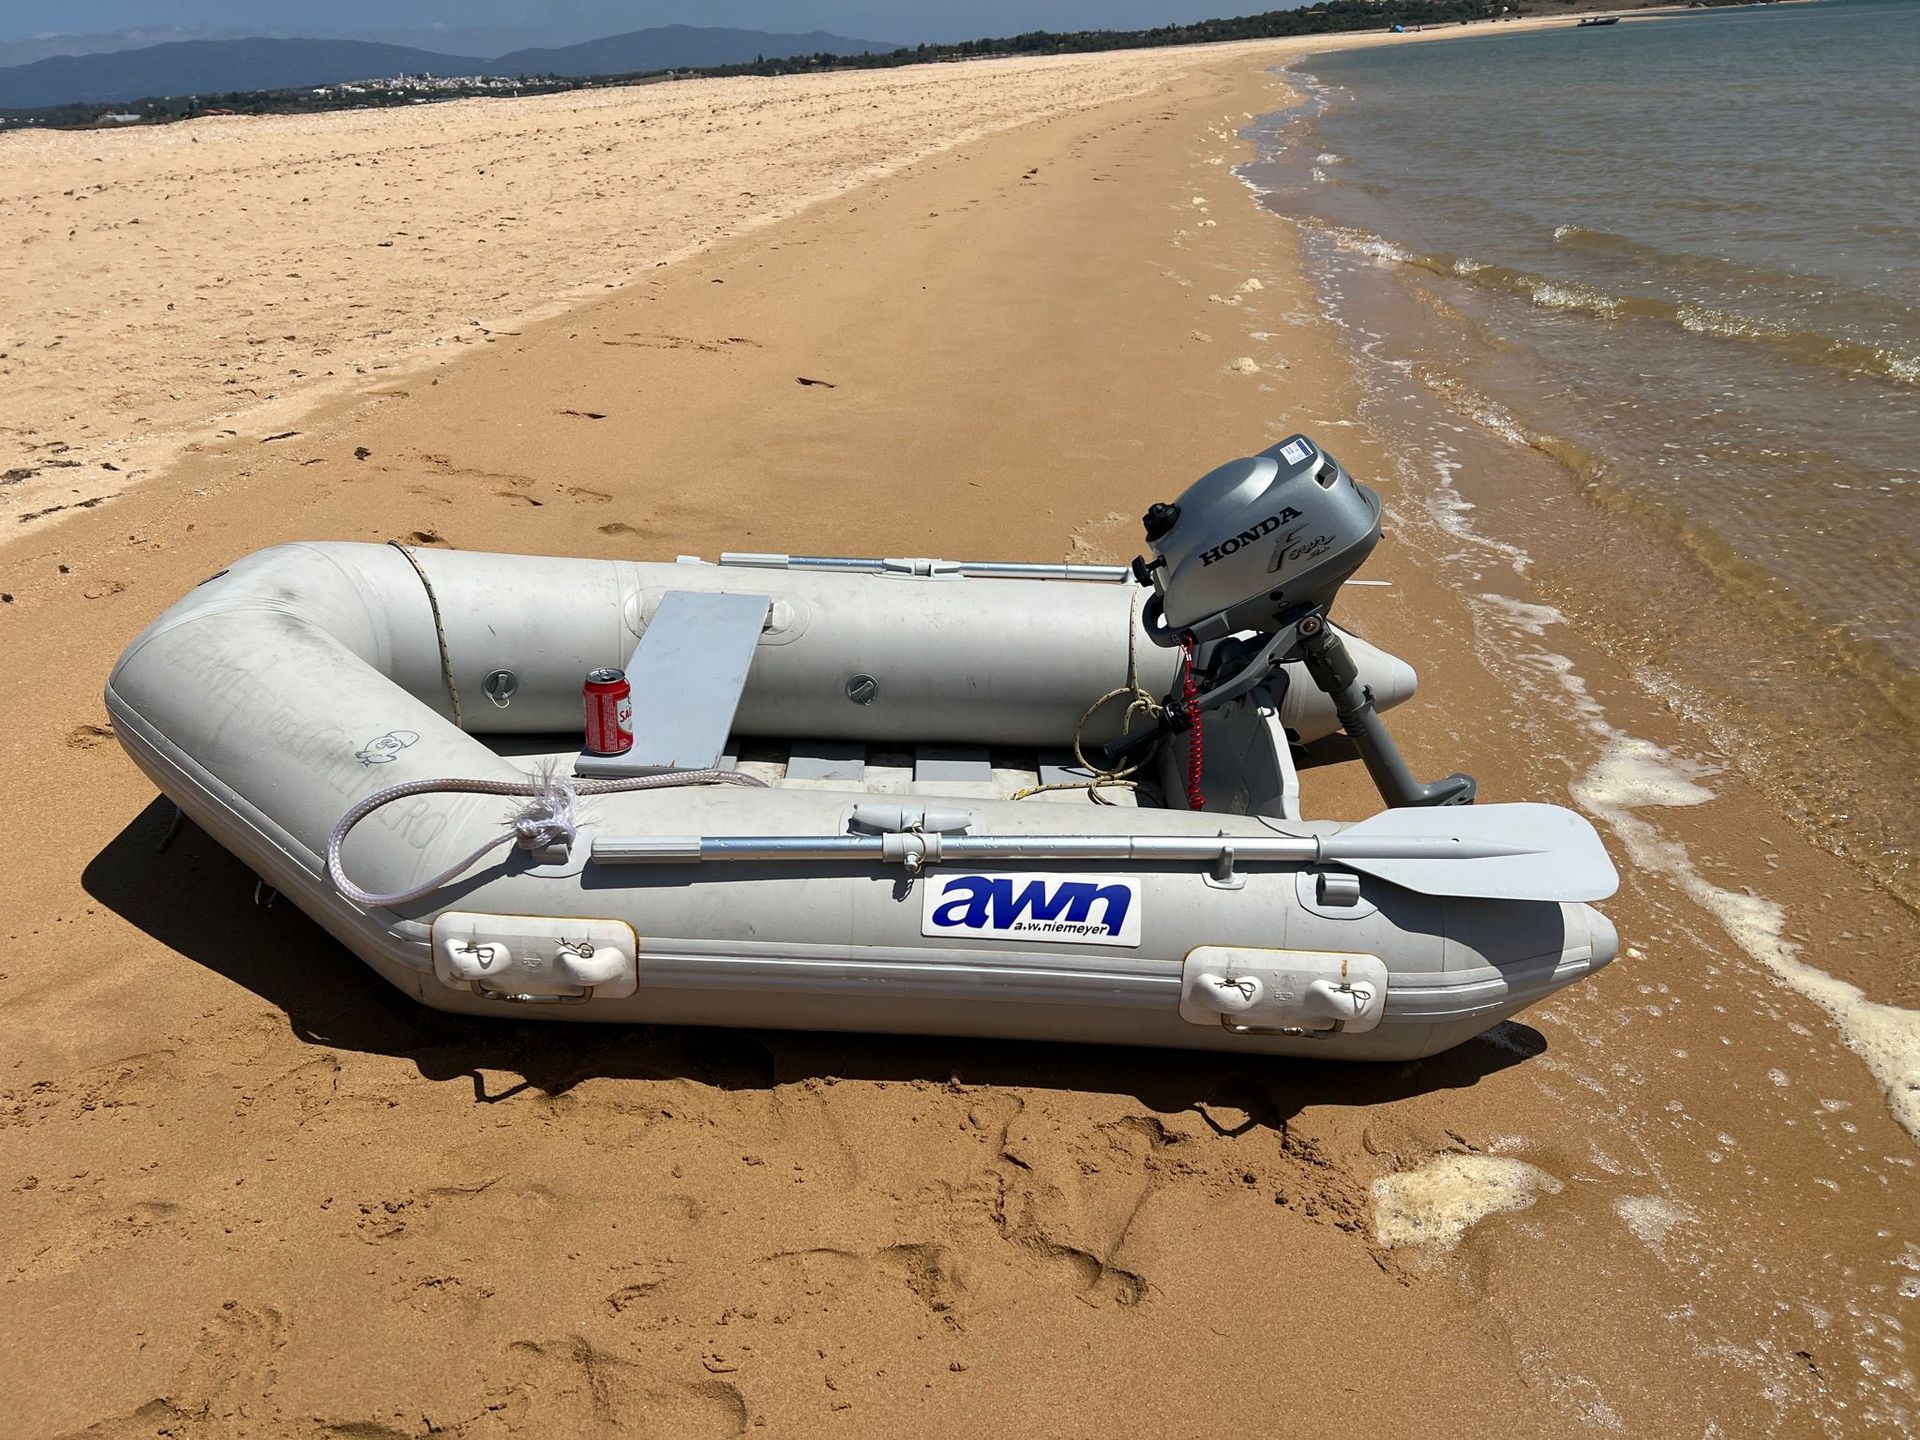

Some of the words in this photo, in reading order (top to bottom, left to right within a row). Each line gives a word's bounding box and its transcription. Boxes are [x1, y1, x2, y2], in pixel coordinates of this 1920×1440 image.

[1198, 506, 1303, 568] HONDA
[932, 875, 1132, 937] awn
[1013, 921, 1108, 936] a.w.niemeyer
